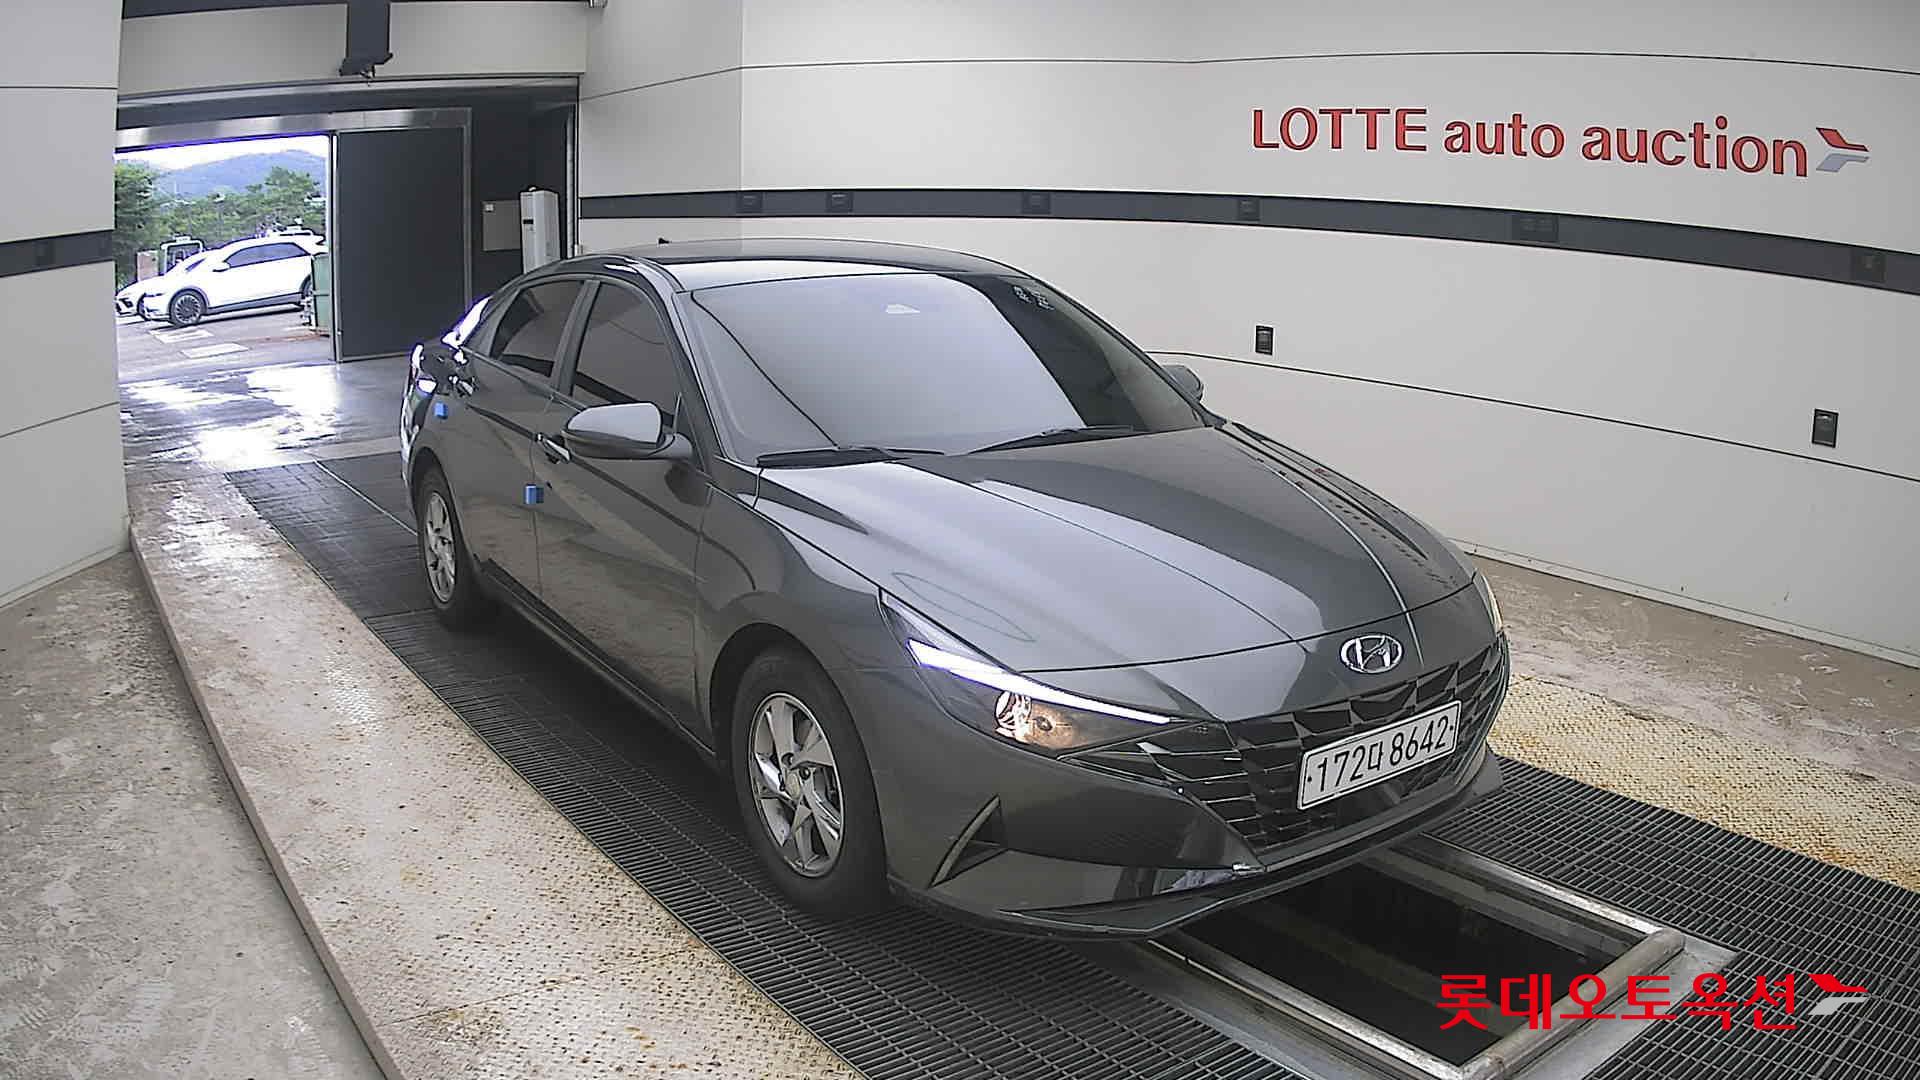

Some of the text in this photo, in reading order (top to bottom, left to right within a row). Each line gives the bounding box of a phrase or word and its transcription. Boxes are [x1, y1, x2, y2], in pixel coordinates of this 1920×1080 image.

[1252, 107, 1809, 177] LOTTE auto auction
[1317, 715, 1449, 792] 172다 8642
